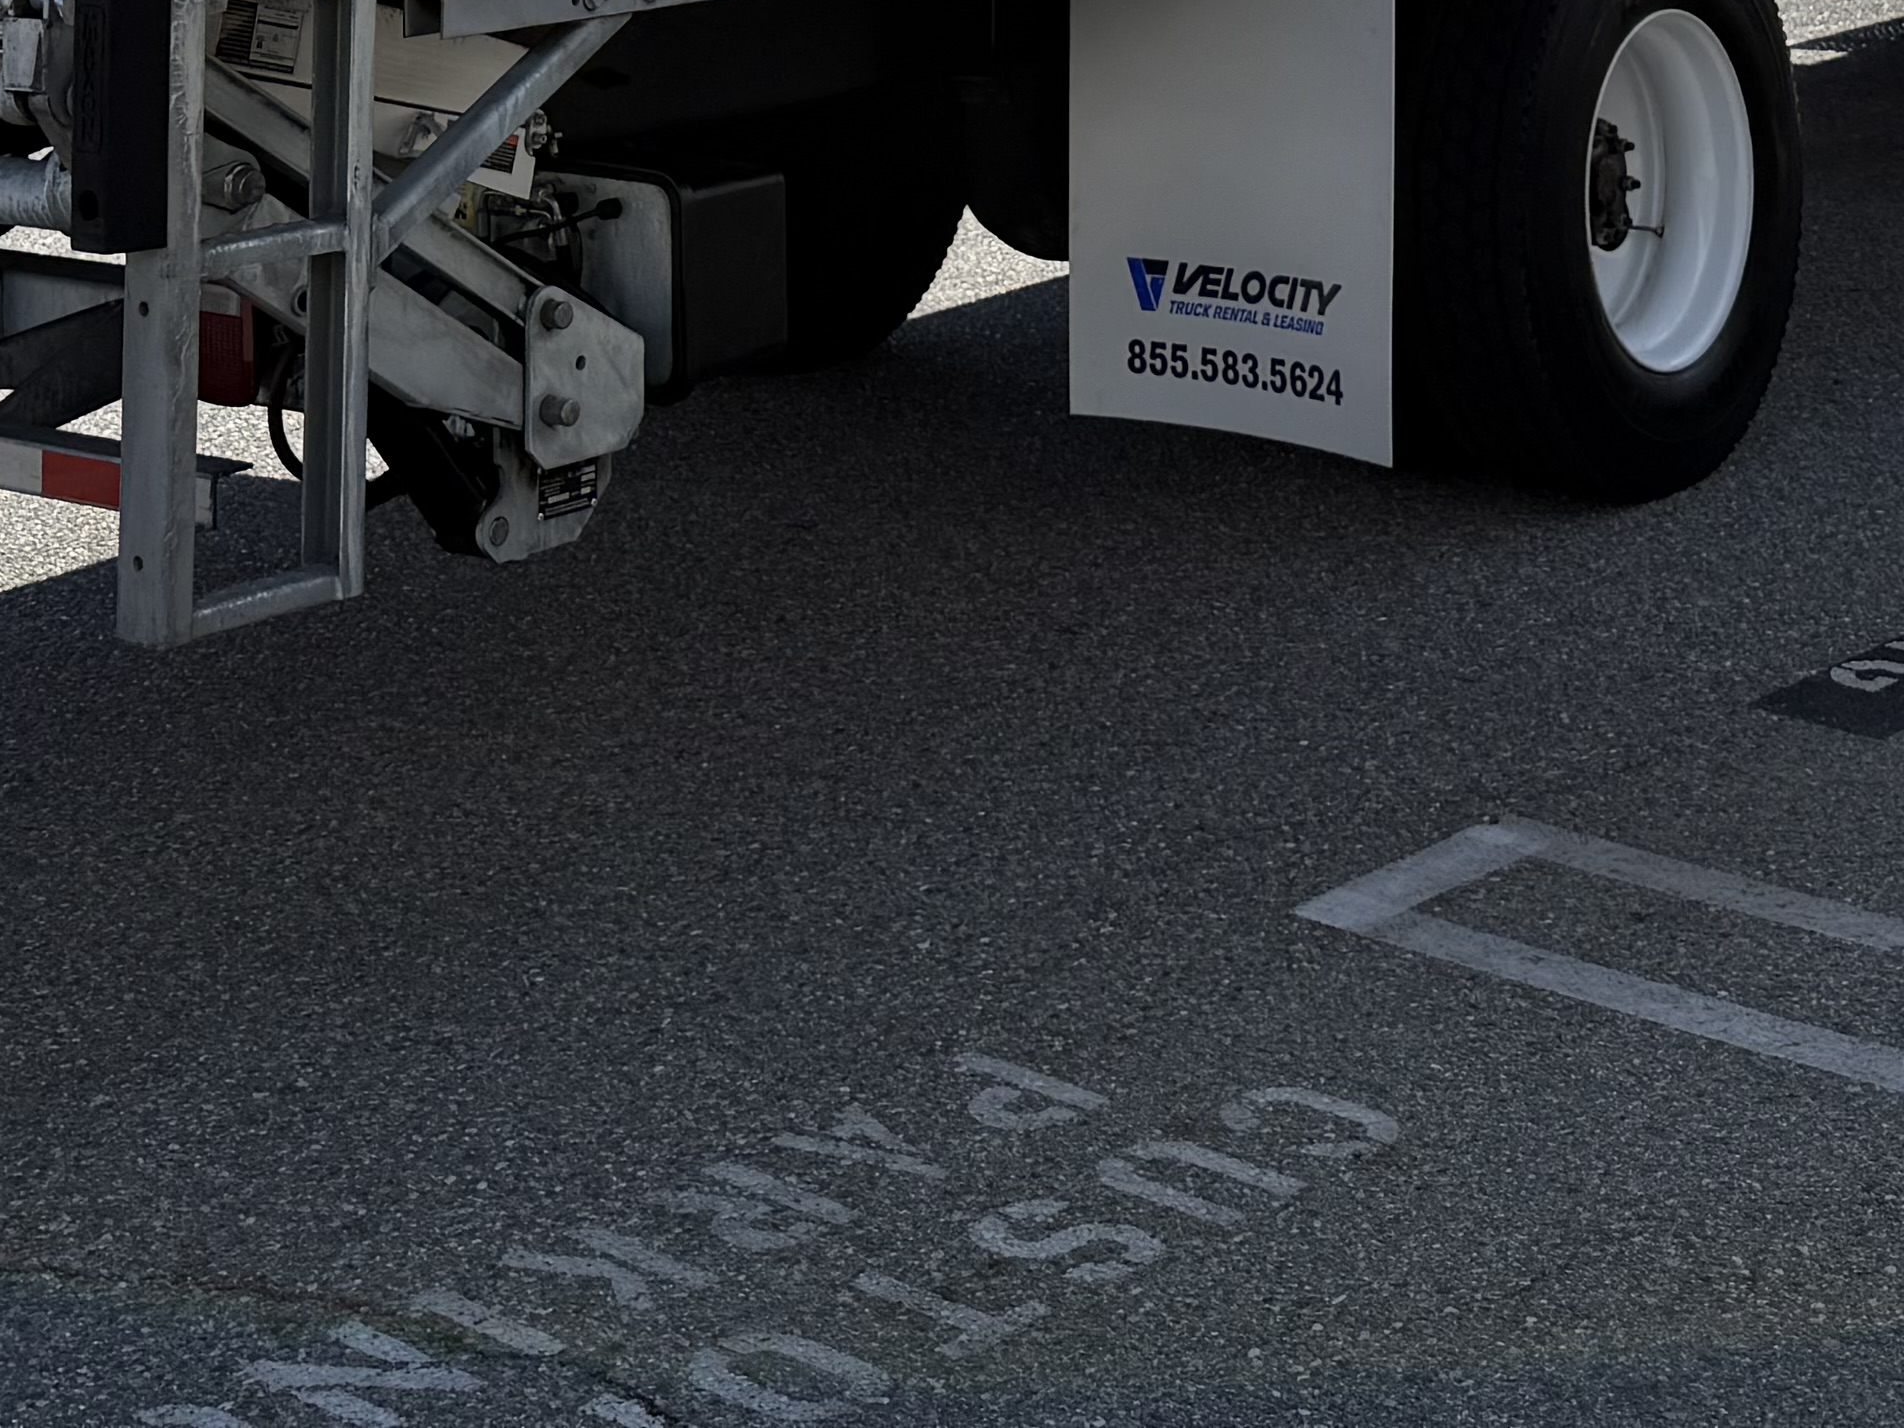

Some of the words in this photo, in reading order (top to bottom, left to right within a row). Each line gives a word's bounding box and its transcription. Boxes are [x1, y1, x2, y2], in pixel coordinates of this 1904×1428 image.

[1172, 261, 1342, 316] VELOCITY
[1169, 299, 1211, 318] TRUCK
[1213, 305, 1259, 325] RENTAL
[1261, 312, 1271, 327] &
[1273, 312, 1325, 336] LEASING
[1127, 338, 1344, 406] 855.583.5624
